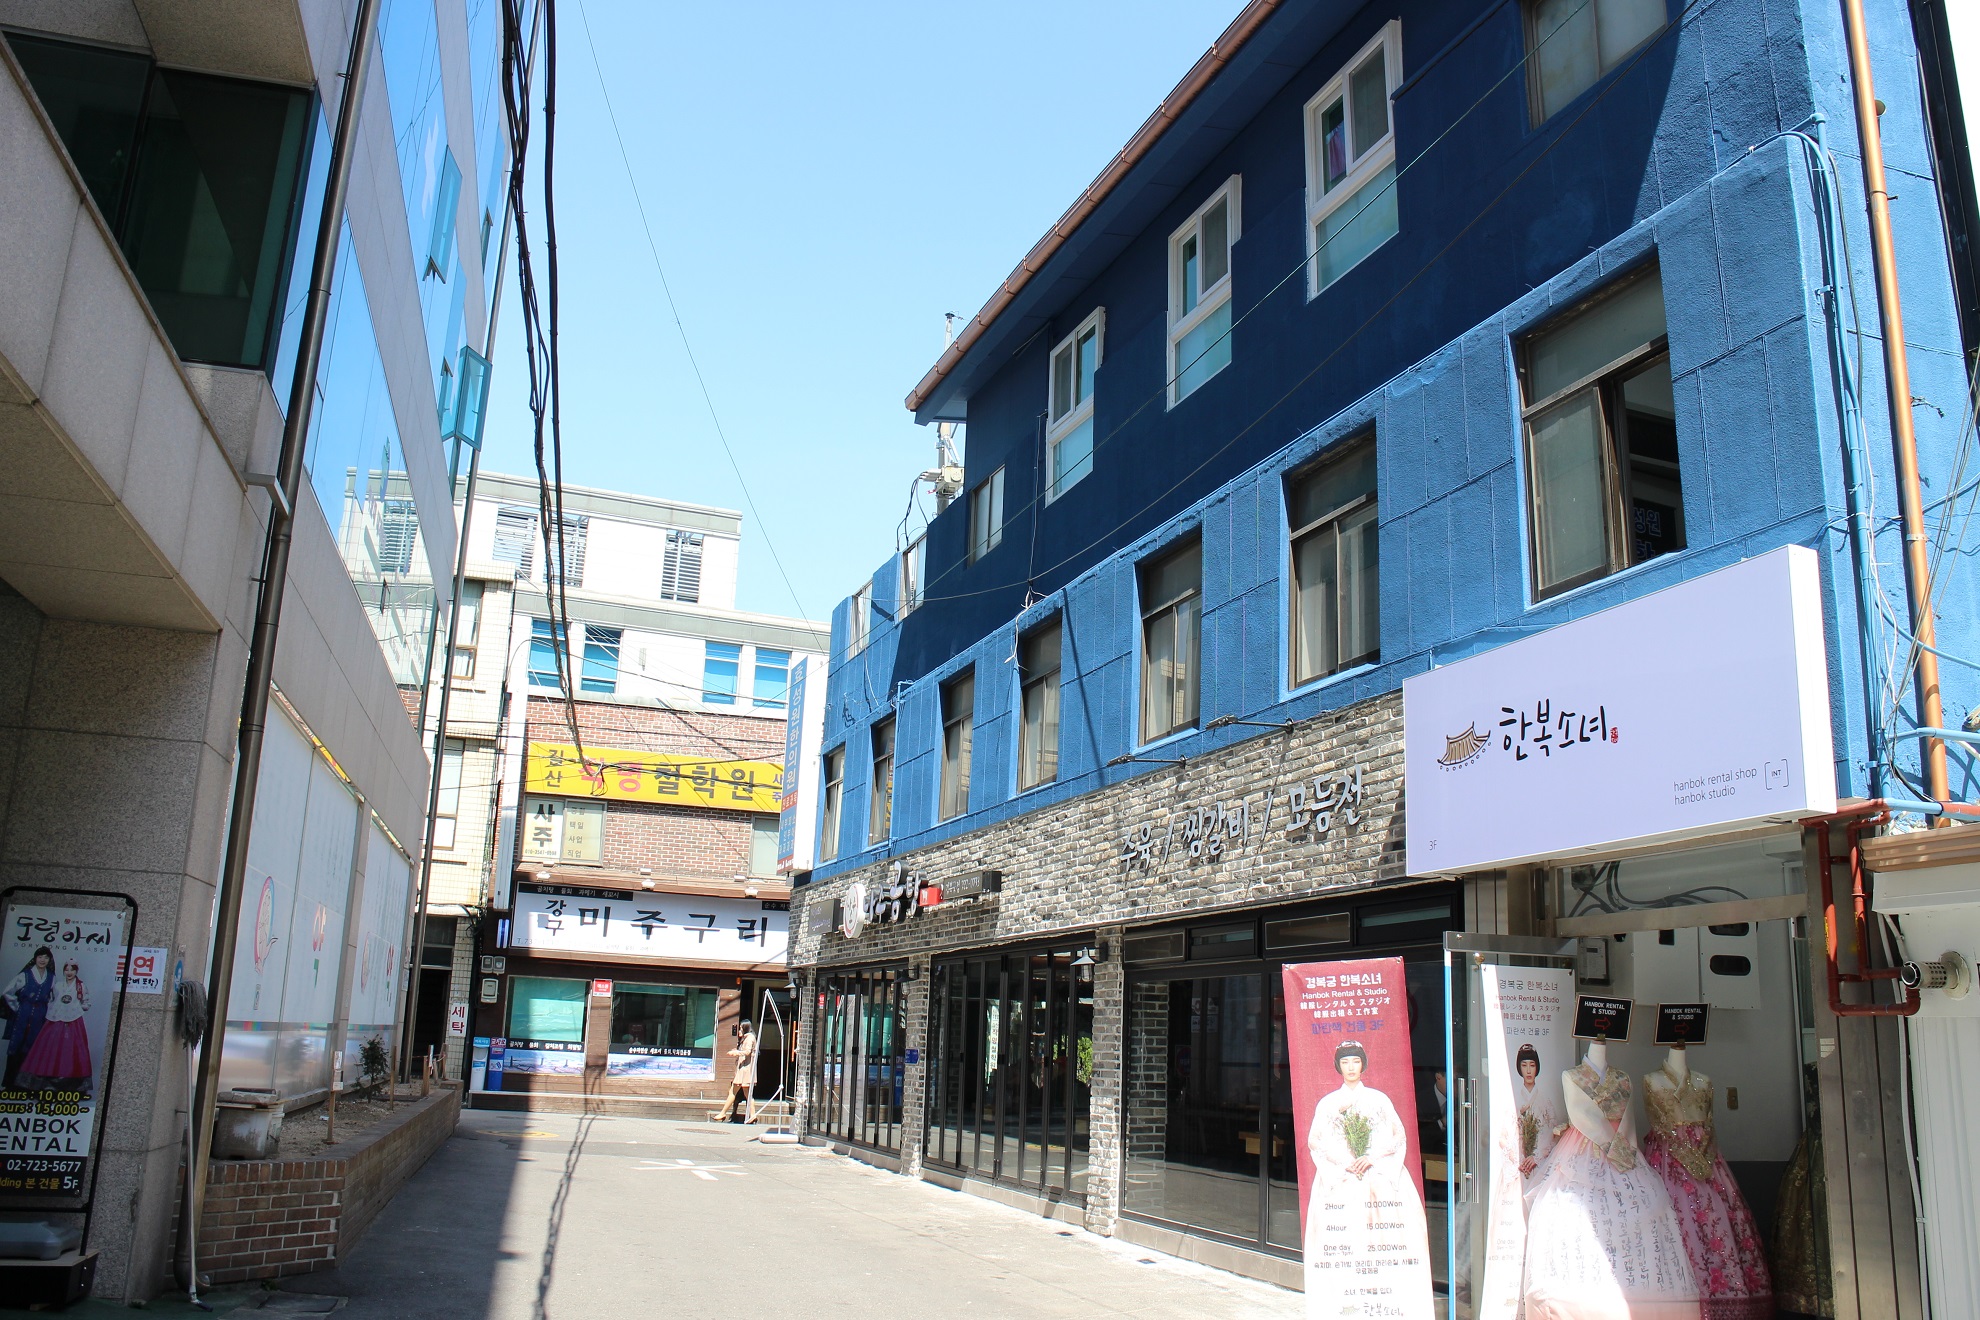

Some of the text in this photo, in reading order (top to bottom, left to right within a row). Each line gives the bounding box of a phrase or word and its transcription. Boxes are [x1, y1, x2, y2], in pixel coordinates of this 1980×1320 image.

[1499, 698, 1607, 761] 한복소녀
[1673, 768, 1757, 792] hanbok rental shop
[1674, 785, 1736, 805] hanbok studio
[1120, 822, 1154, 871] 수육
[1286, 764, 1362, 833] 모듬전
[532, 803, 556, 847] 사주
[569, 821, 584, 830] 택일
[568, 835, 583, 844] 사업
[1429, 839, 1437, 850] 3F
[567, 849, 582, 858] 직업
[577, 906, 768, 948] 미주구리
[1305, 973, 1382, 988] 경복궁 한복소녀
[1500, 979, 1558, 991] 경복궁 한복소녀
[1364, 988, 1388, 996] Studio
[1584, 1000, 1625, 1010] HANBOK RENTAL
[452, 1006, 465, 1034] 세탁
[1311, 1019, 1384, 1035] 파란색 건물 3F
[1506, 1026, 1525, 1035] 파란색
[1541, 1028, 1550, 1036] 3F
[38, 1091, 80, 1102] 10,000
[0, 1117, 81, 1134] ANBOK
[7, 1160, 81, 1173] 02-723-5677
[25, 1178, 36, 1189] 본
[38, 1178, 60, 1189] 건물
[63, 1176, 78, 1189] 5F
